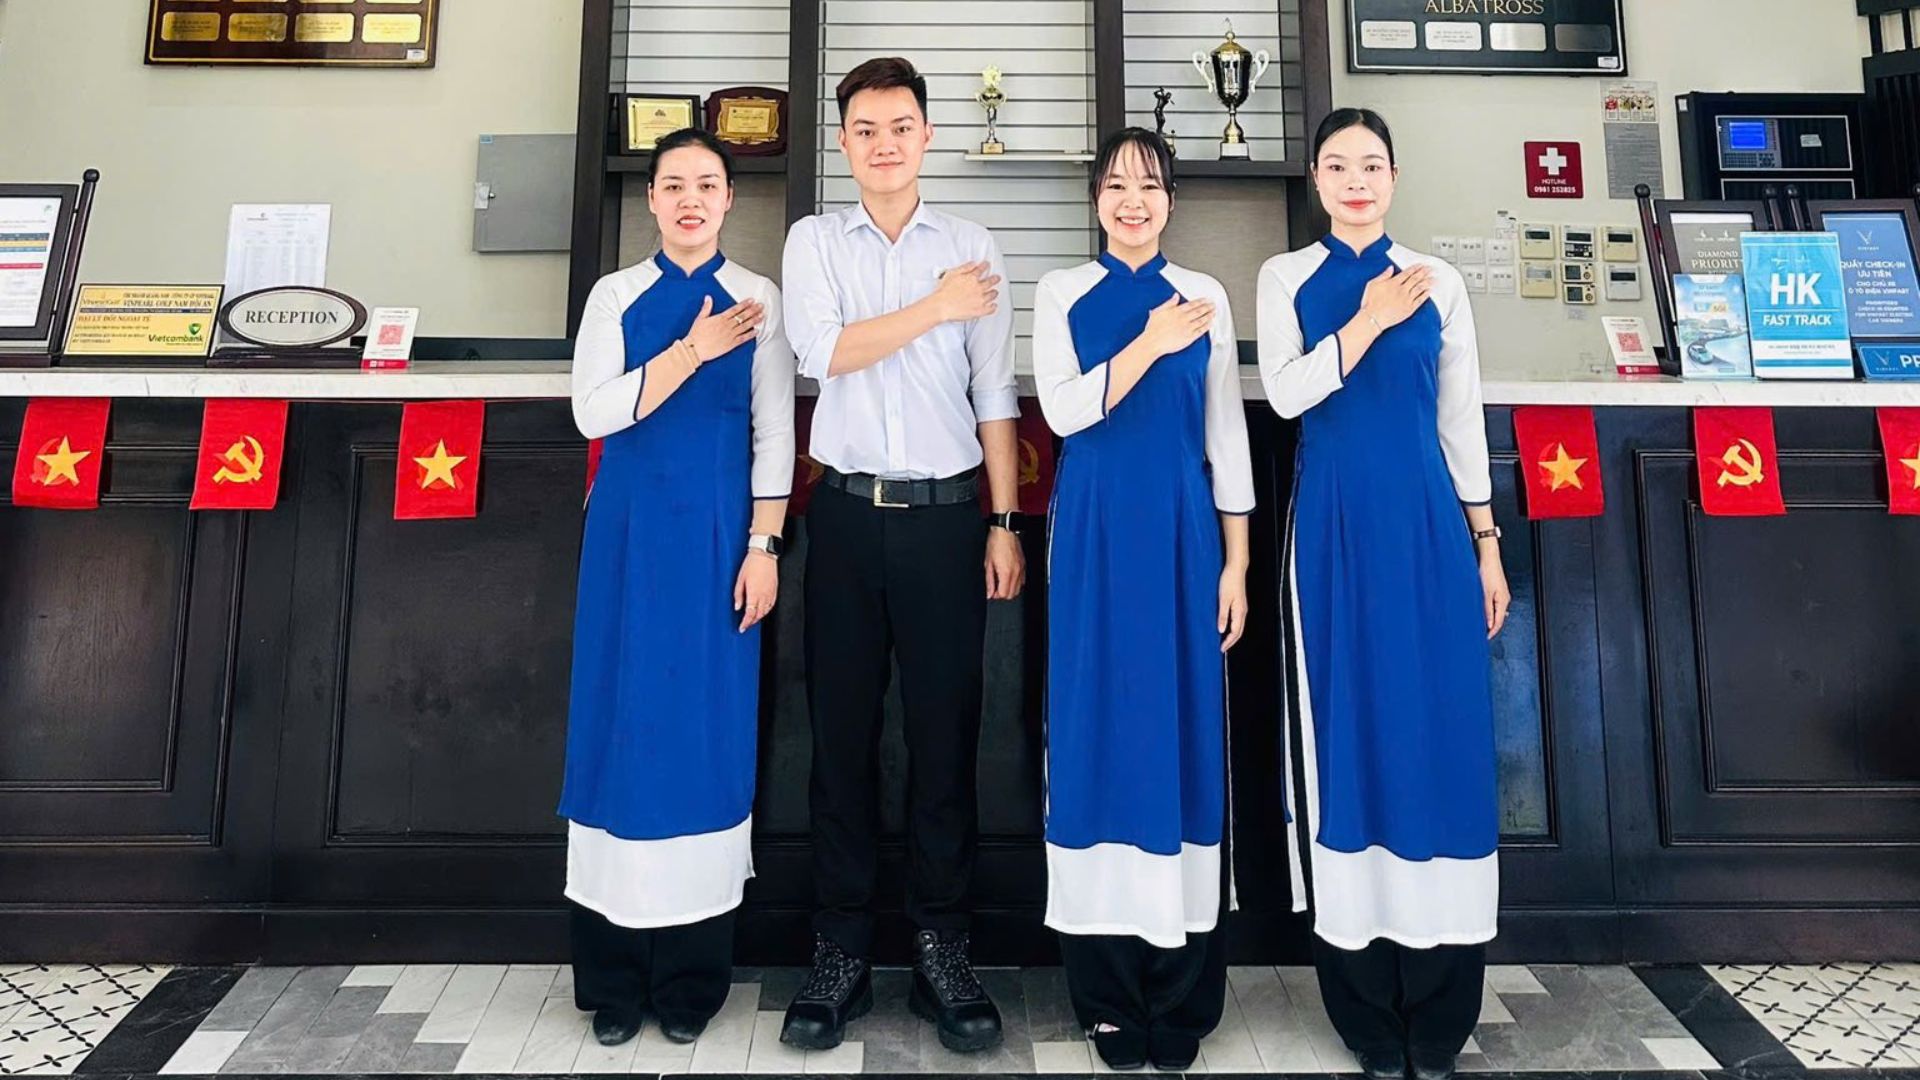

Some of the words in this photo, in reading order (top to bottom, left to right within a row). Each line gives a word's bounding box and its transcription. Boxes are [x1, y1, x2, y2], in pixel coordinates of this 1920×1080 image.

[1424, 0, 1545, 15] ALBATROSS
[1697, 250, 1739, 258] DIAMOND
[1770, 272, 1822, 305] HK
[245, 310, 339, 324] RECEPTION
[1763, 314, 1791, 326] FAST
[1794, 314, 1832, 326] TRACK
[148, 335, 203, 343] Vietcombank
